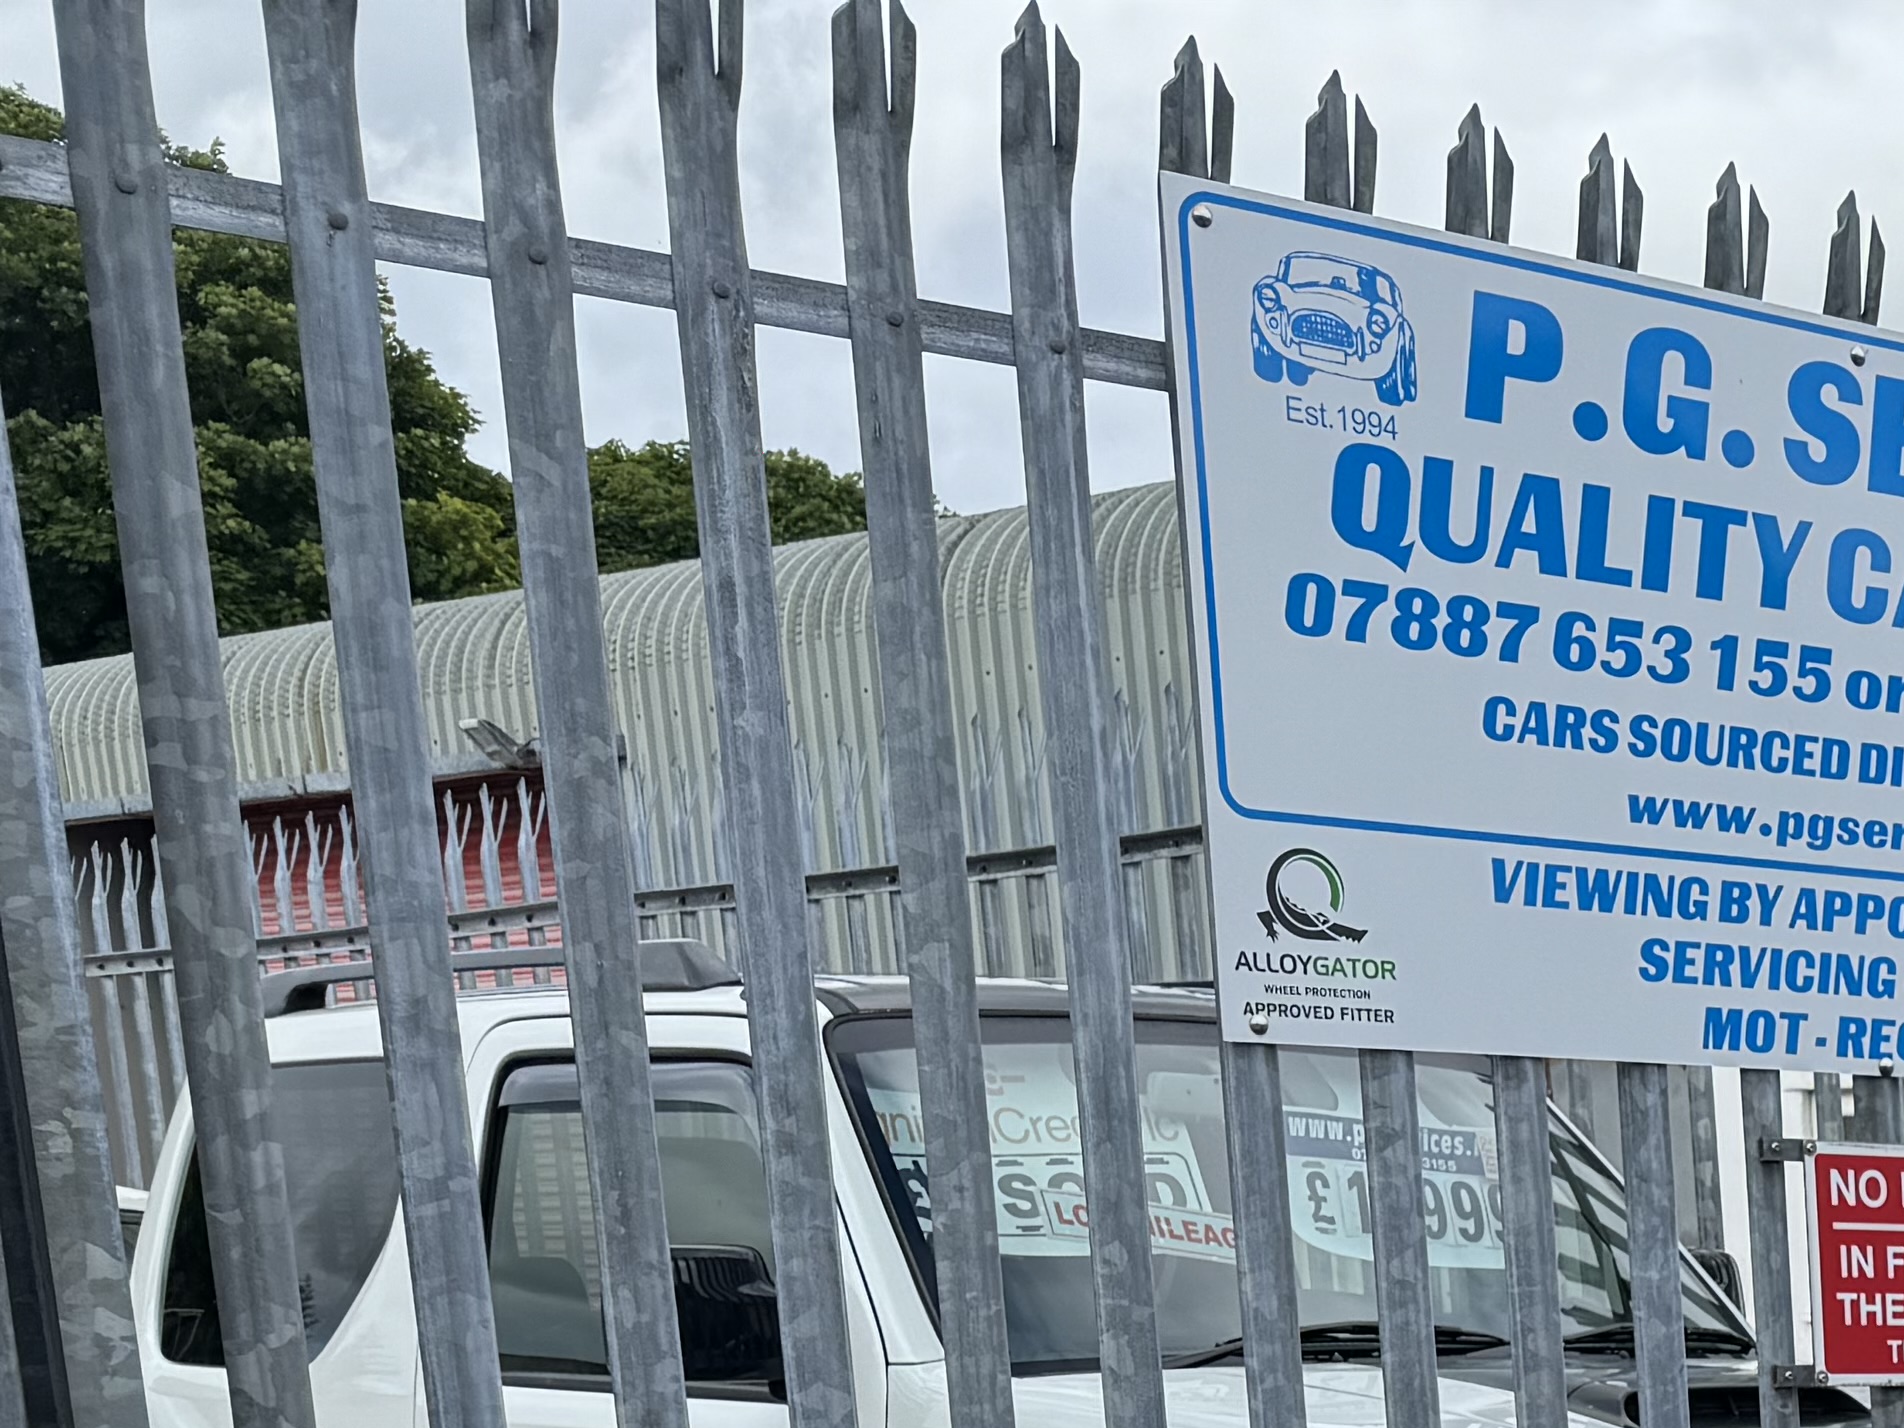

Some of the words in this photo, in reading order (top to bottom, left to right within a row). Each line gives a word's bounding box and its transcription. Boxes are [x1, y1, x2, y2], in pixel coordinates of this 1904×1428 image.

[1464, 291, 1756, 470] P.G.
[1286, 395, 1399, 441] Est.1994
[1330, 442, 1814, 612] QUALITY
[1284, 571, 1542, 664] 07887
[1552, 611, 1694, 686] 653
[1710, 634, 1834, 704] 155
[1482, 695, 1621, 755] CARS
[1627, 713, 1852, 782] SOURCED
[1490, 857, 1712, 922] VIEWING
[1718, 880, 1784, 928] BY
[1234, 950, 1397, 981] ALLOYGATOR
[1639, 937, 1898, 1000] SERVICING
[1243, 1001, 1335, 1020] APPROVED
[1340, 1006, 1395, 1023] FITTER
[1263, 984, 1302, 997] WHEEL
[1304, 986, 1371, 1000] PROTECTION
[1702, 1006, 1809, 1056] MOT
[1829, 1168, 1888, 1208] NO
[1840, 1244, 1875, 1279] IN
